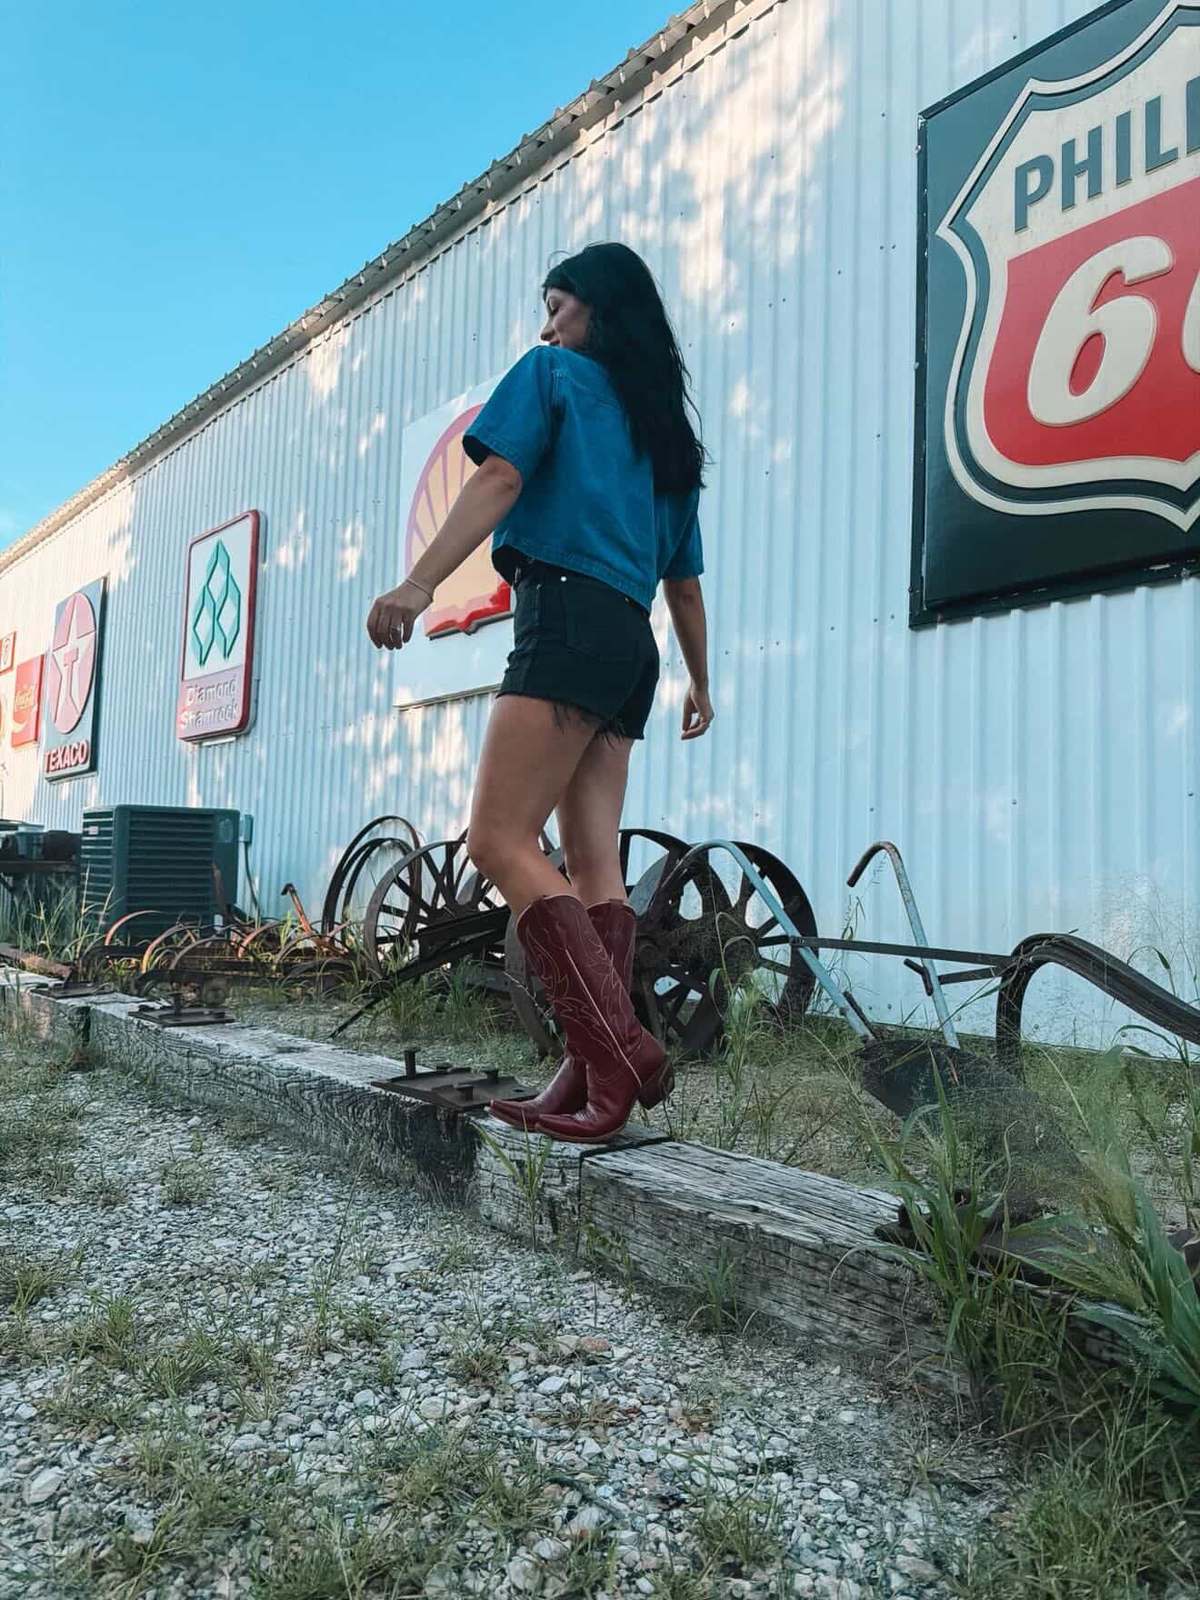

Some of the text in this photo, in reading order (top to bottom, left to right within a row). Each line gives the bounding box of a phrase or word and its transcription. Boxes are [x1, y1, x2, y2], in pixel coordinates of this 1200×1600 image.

[1027, 236, 1200, 428] 6
[185, 675, 237, 706] Diamond
[179, 699, 239, 728] Shamrock
[45, 739, 89, 773] TEXACO
